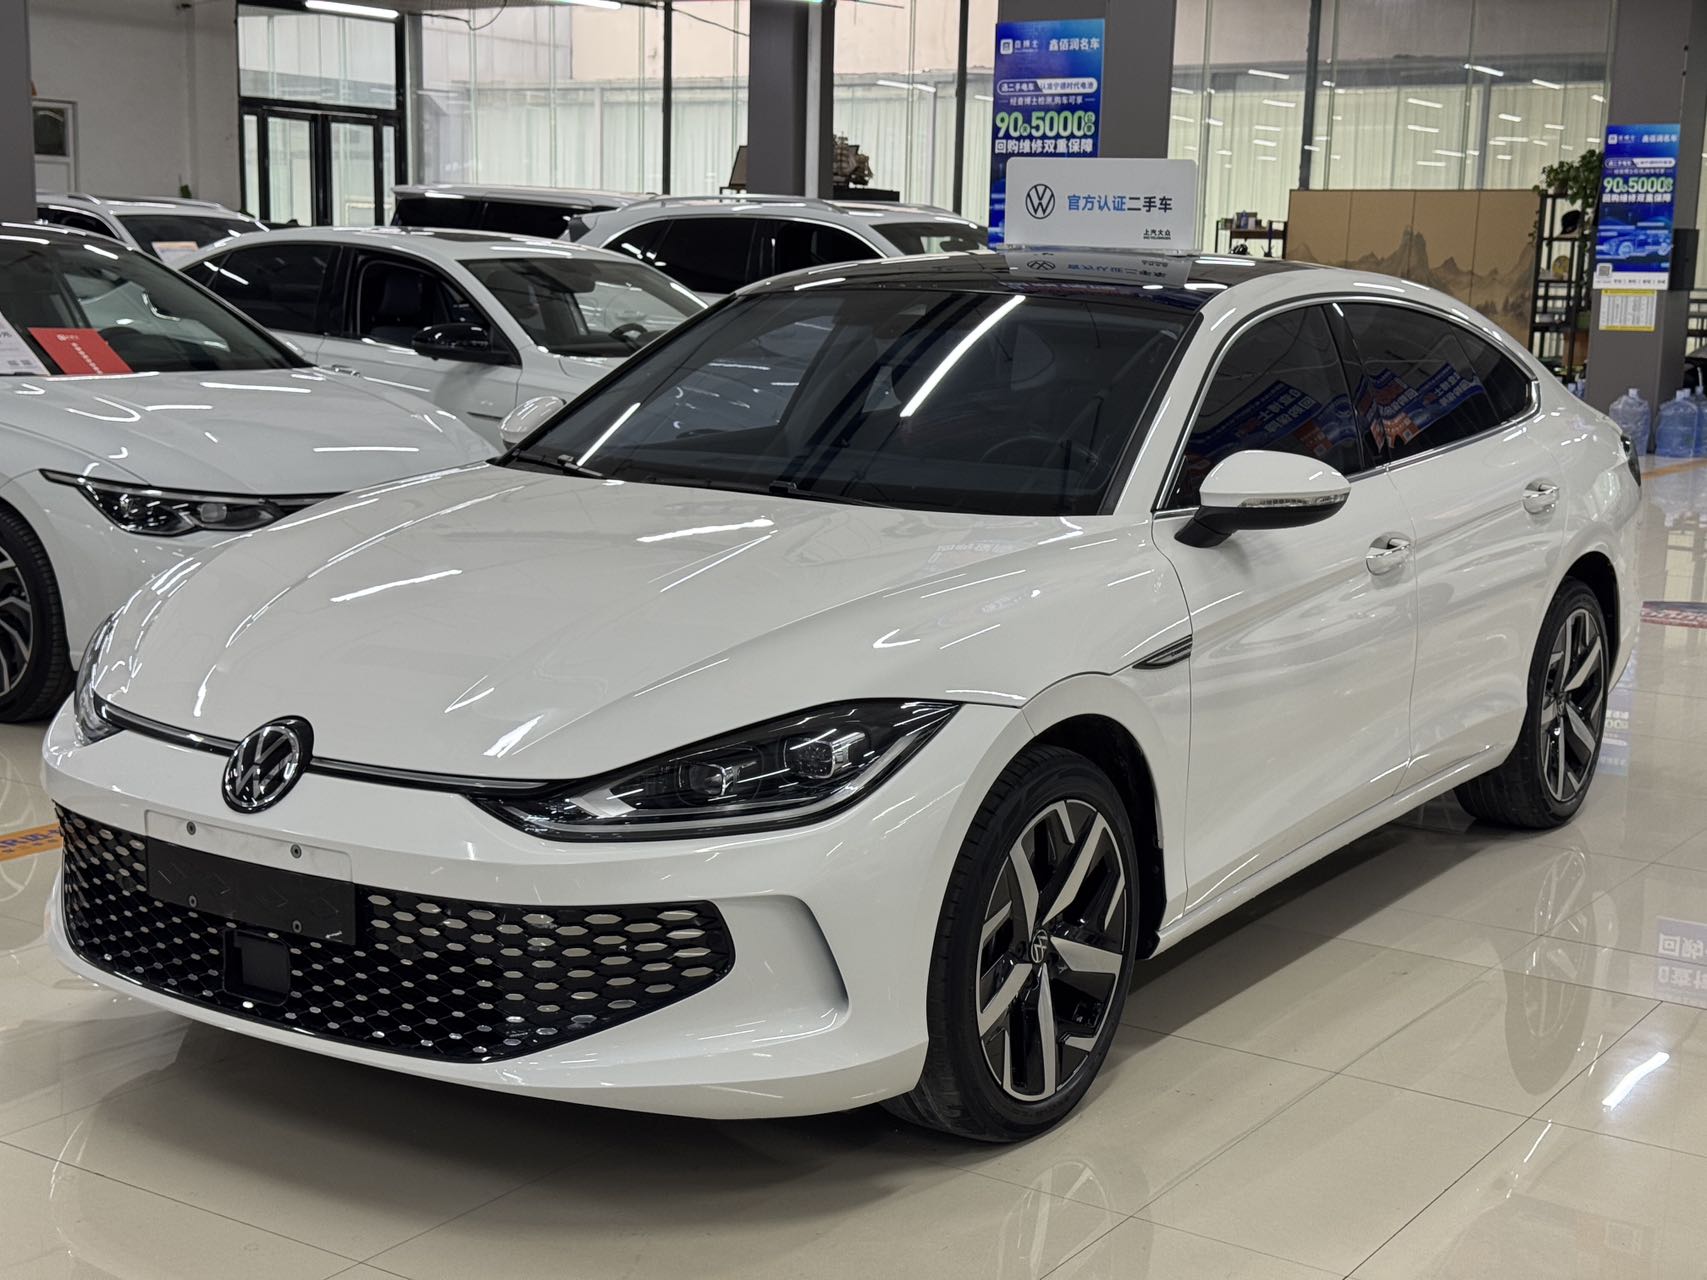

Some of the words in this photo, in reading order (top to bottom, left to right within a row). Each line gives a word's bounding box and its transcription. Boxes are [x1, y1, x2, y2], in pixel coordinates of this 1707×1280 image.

[994, 138, 1093, 154] 回购维修双重保障
[1067, 194, 1173, 213] 官方认证二手车
[1143, 228, 1171, 236] 上汽大众
